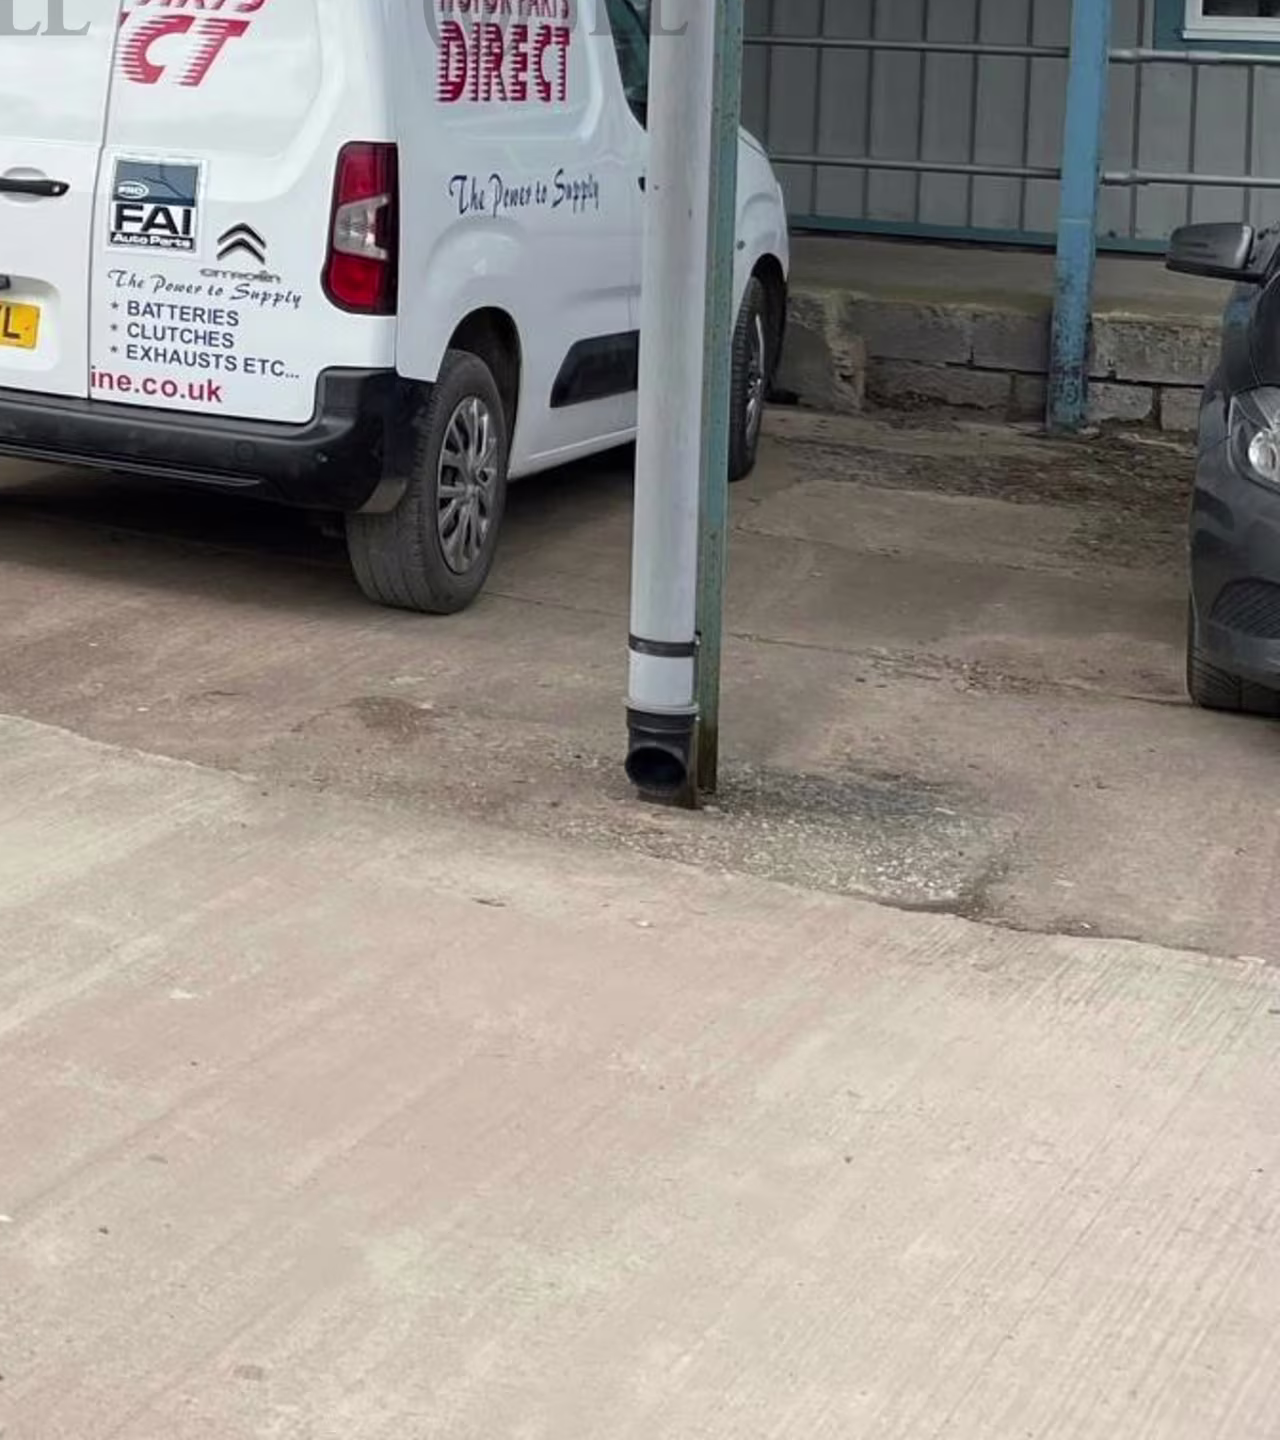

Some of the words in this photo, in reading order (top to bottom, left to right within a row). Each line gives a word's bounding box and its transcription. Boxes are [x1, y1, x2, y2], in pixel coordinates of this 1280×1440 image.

[116, 12, 251, 86] CT
[436, 21, 570, 101] DIRECT
[449, 175, 484, 214] The
[488, 173, 532, 218] Power
[536, 181, 547, 204] to
[551, 168, 599, 213] Supply
[114, 203, 192, 236] FAI
[112, 233, 148, 245] Auto
[149, 236, 191, 248] Parts
[108, 269, 145, 289] The
[151, 274, 203, 295] Power
[207, 284, 224, 296] to
[229, 283, 302, 309] Supply
[127, 300, 239, 327] BATTERIES
[127, 322, 235, 349] CLUTCHES
[126, 344, 237, 372] EXHAUSTS
[91, 365, 223, 403] ine.co.uk
